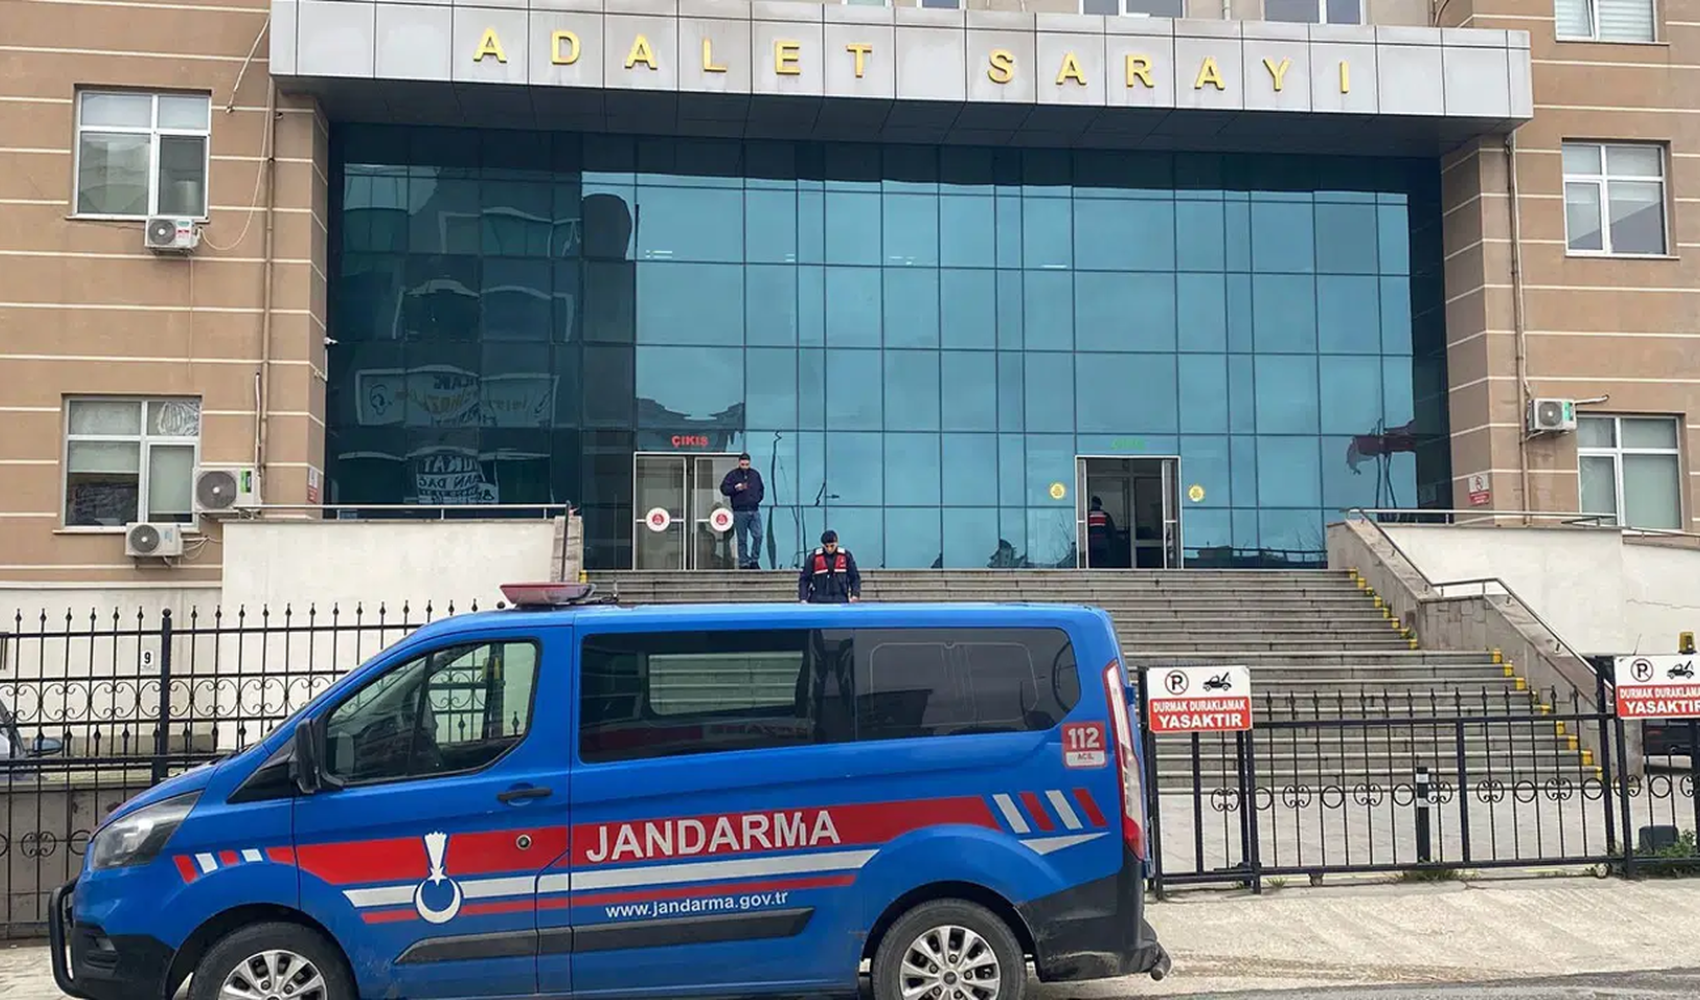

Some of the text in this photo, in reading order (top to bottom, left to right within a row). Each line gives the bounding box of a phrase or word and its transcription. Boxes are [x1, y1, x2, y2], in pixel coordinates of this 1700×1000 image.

[473, 27, 1351, 94] ADALET SARAYI
[144, 651, 151, 665] 9
[1619, 688, 1654, 700] DURMAK
[1153, 699, 1246, 713] DURMAK DURAKLAMAK
[1158, 713, 1242, 728] YASAKTIR
[1068, 727, 1100, 749] 112
[586, 810, 841, 862] JANDARMA
[605, 891, 789, 918] www.jandarma.gov.tr
